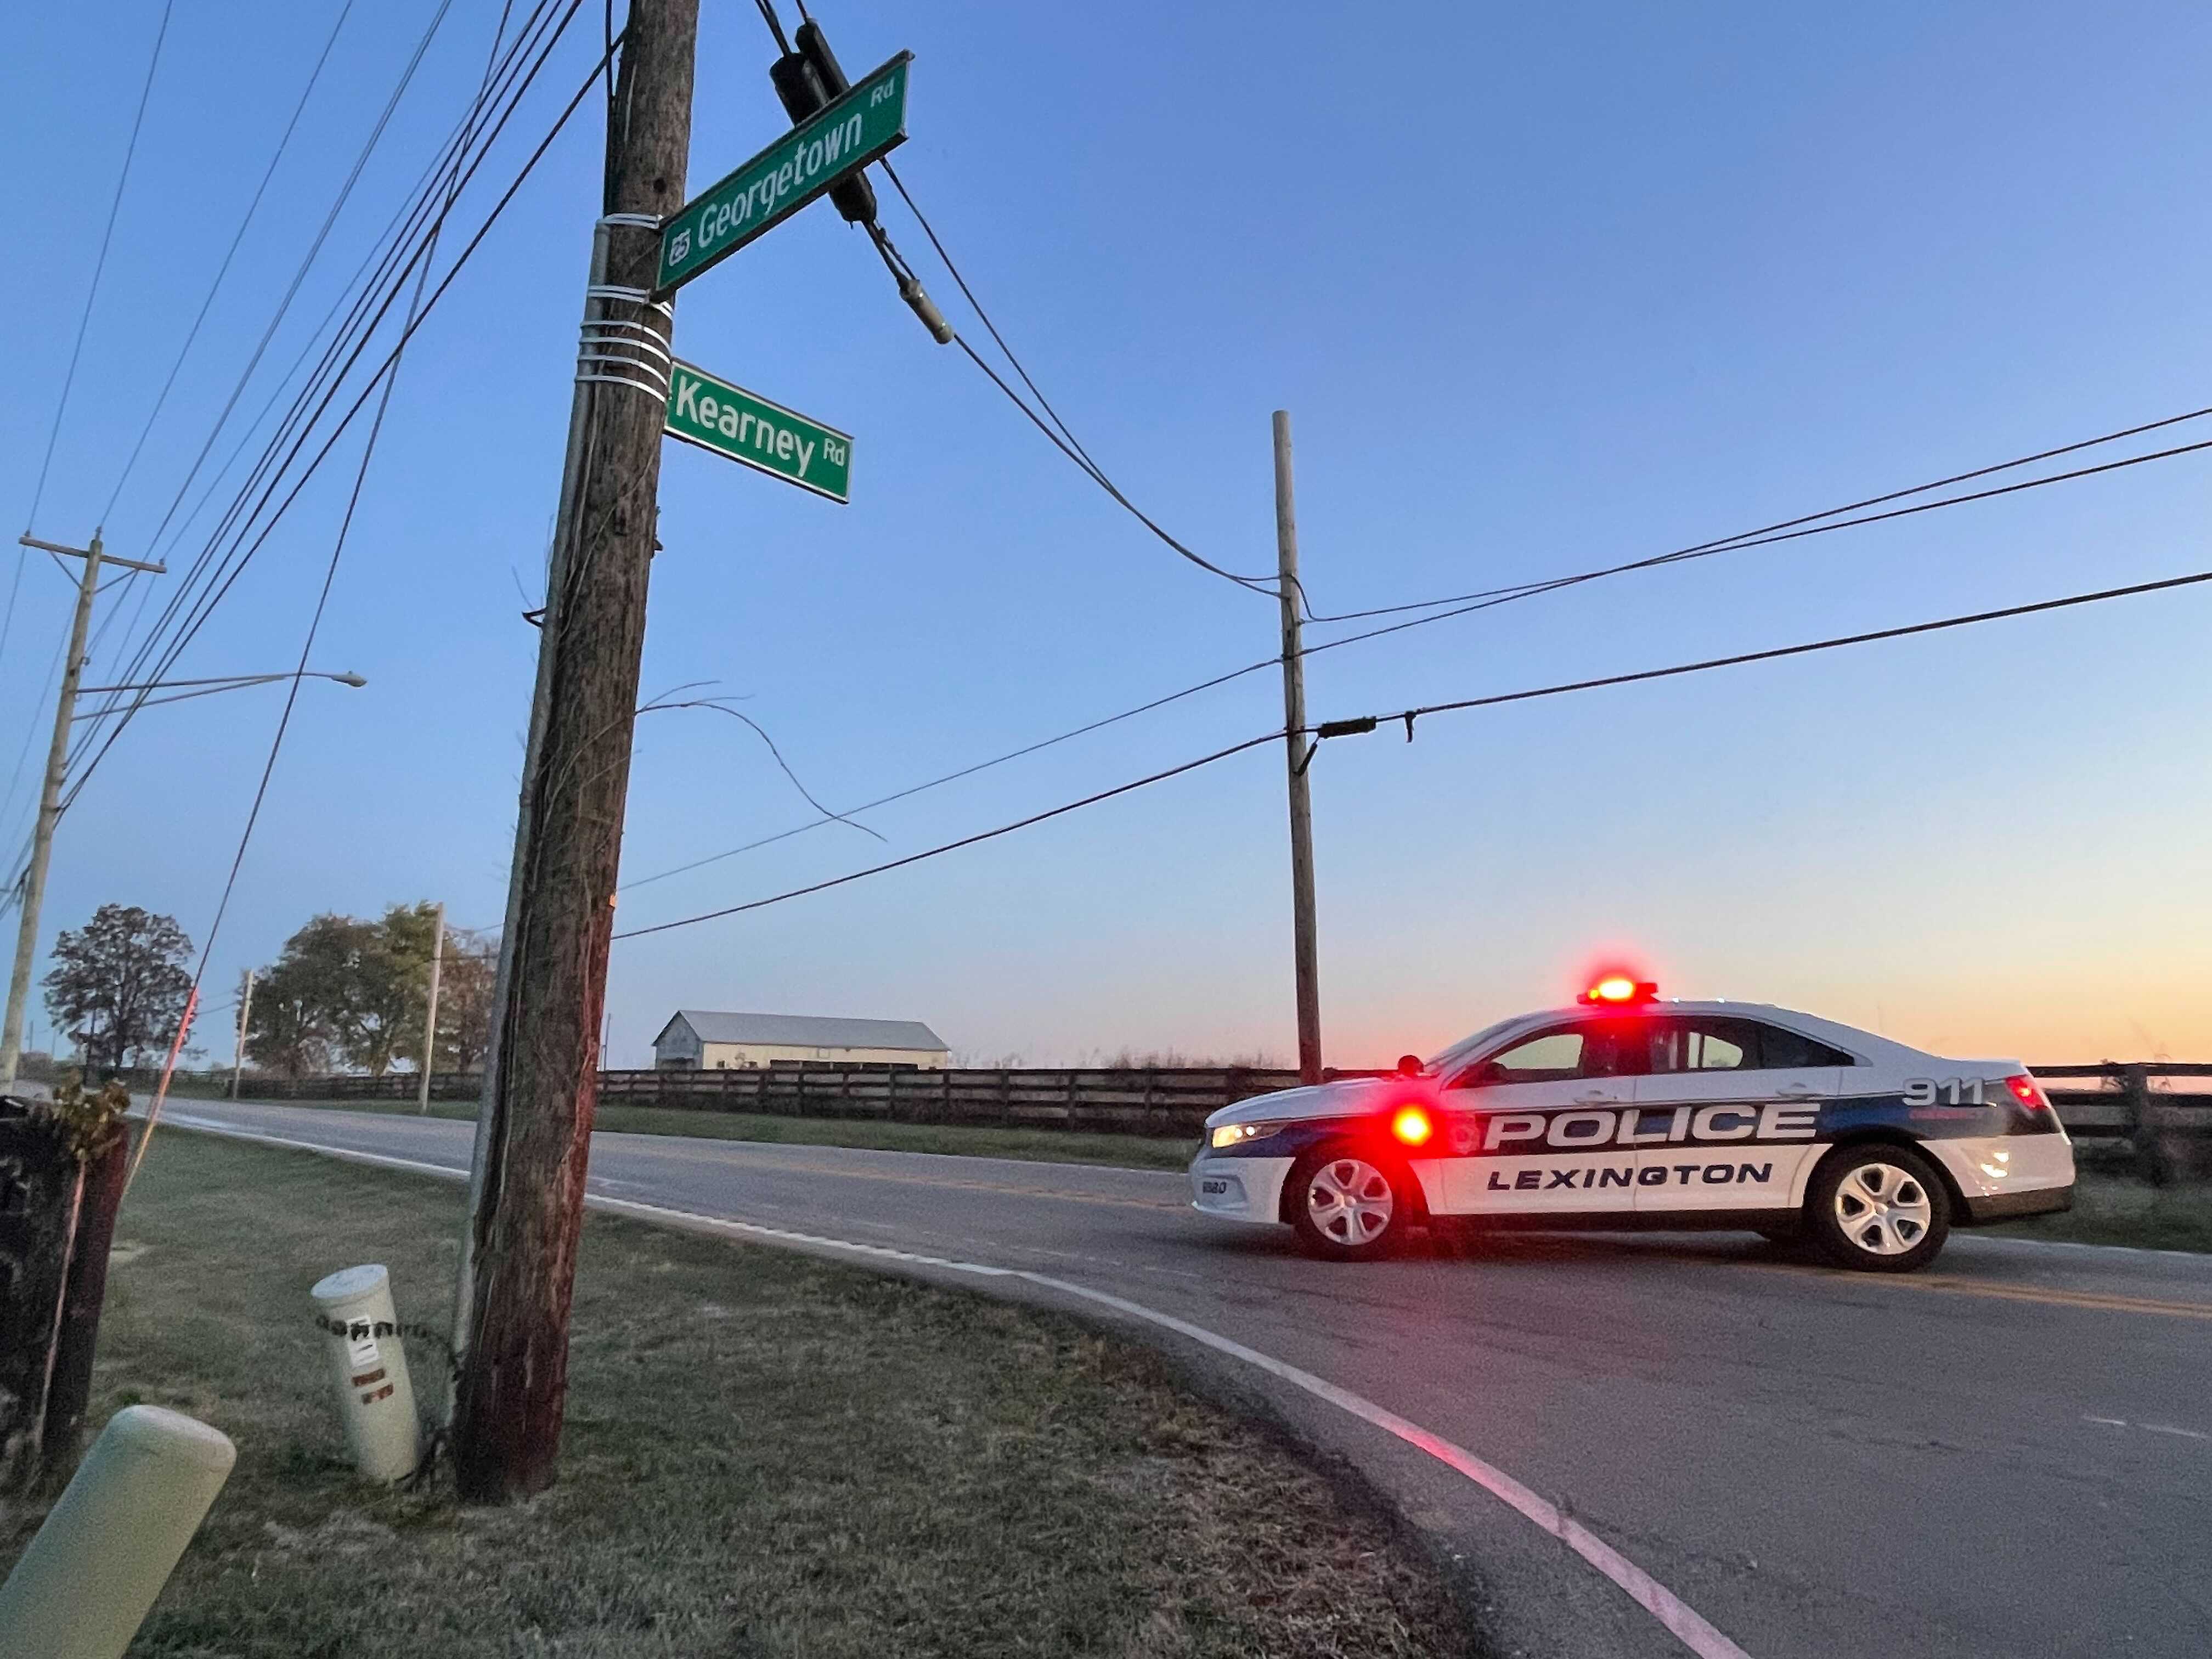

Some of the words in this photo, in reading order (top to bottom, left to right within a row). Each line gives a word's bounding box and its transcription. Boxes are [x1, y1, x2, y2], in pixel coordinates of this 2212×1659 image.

[698, 113, 862, 249] Georgetown
[870, 78, 894, 108] Rd
[676, 375, 815, 477] Kearney
[823, 438, 845, 466] Rd
[1902, 1077, 1984, 1105] 911
[1483, 1103, 1820, 1150] POLICE
[1487, 1163, 1773, 1190] LEXINGTON
